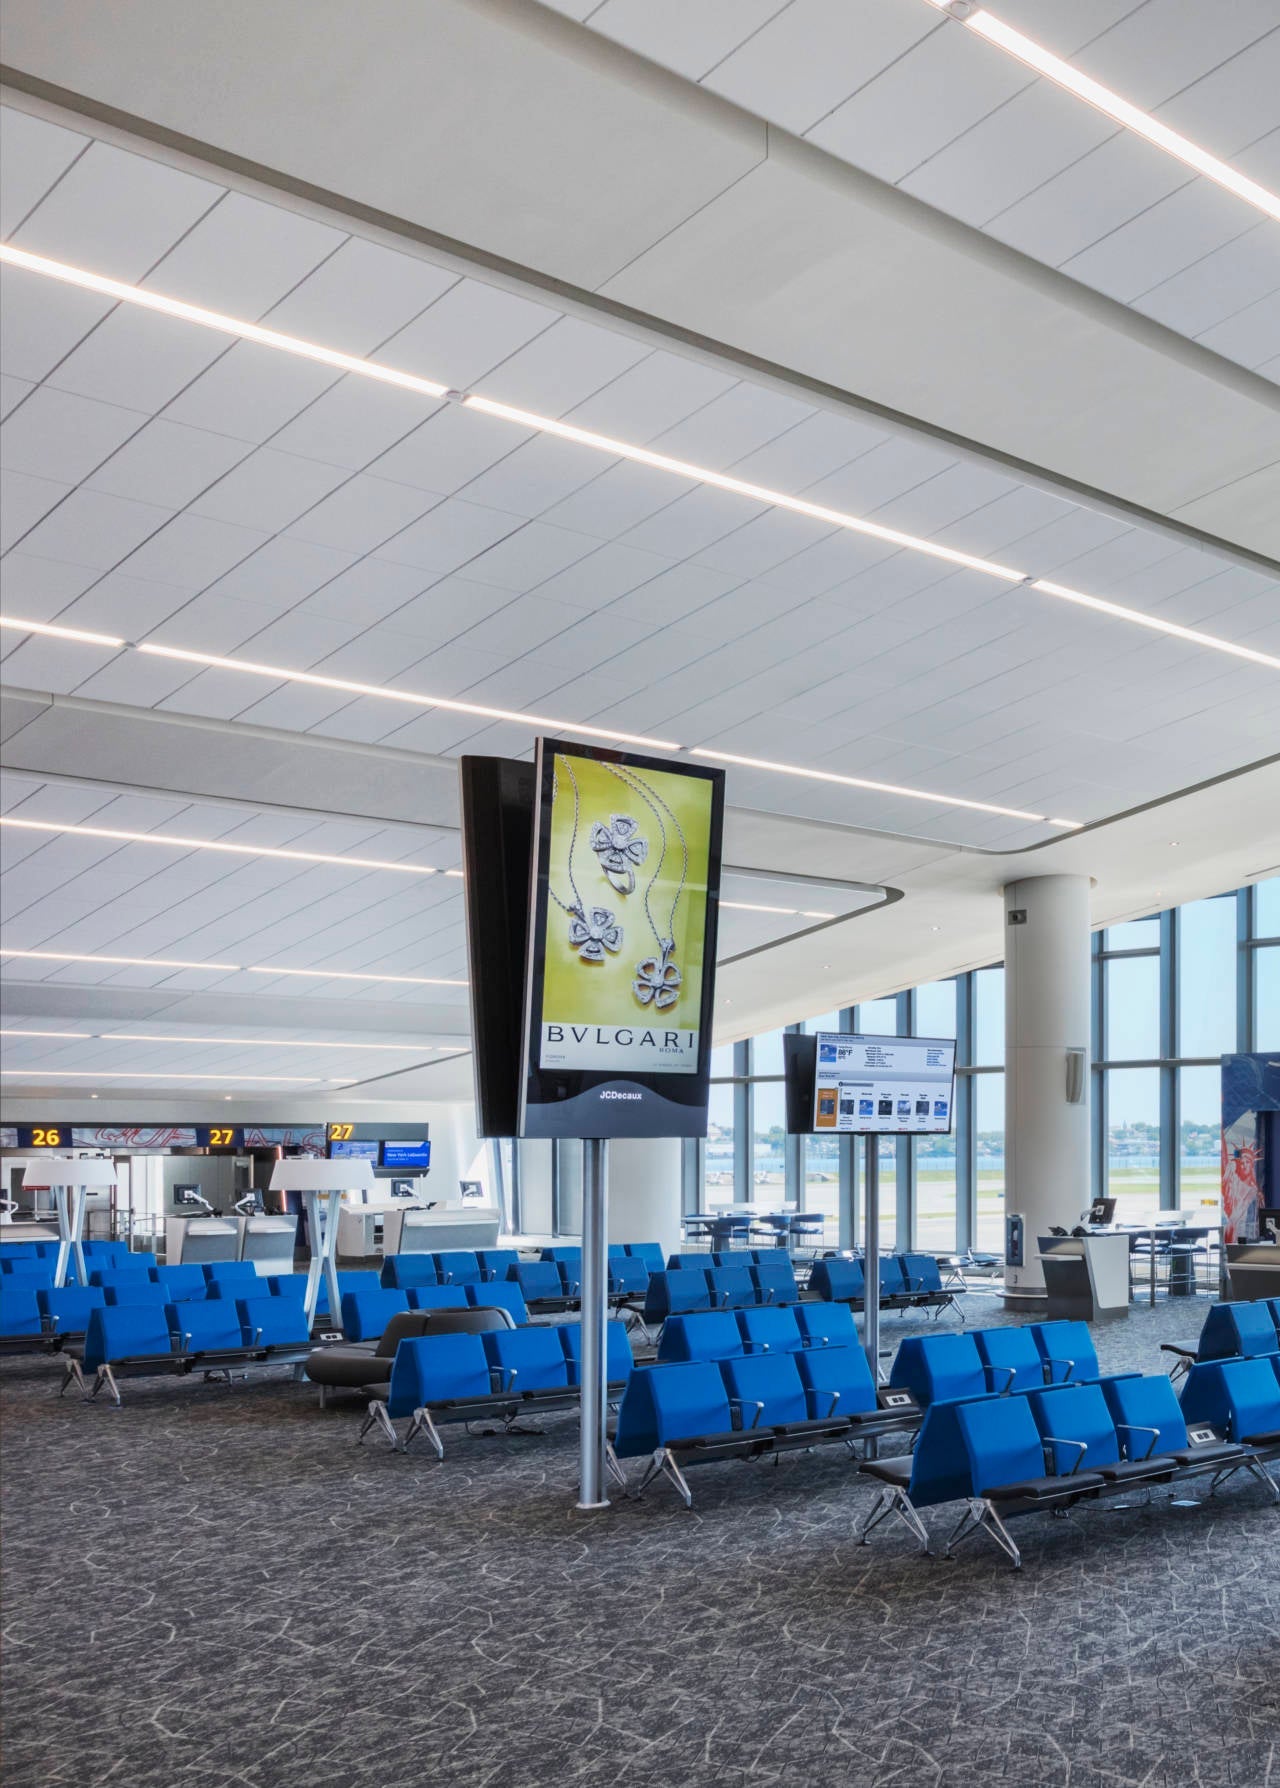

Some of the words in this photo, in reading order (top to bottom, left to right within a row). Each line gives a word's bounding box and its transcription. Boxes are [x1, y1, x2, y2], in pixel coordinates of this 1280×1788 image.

[547, 1025, 694, 1048] BVLGARI
[599, 1091, 642, 1100] JCDecaux
[32, 1129, 60, 1146] 26
[210, 1129, 234, 1145] 27
[330, 1124, 354, 1140] 27
